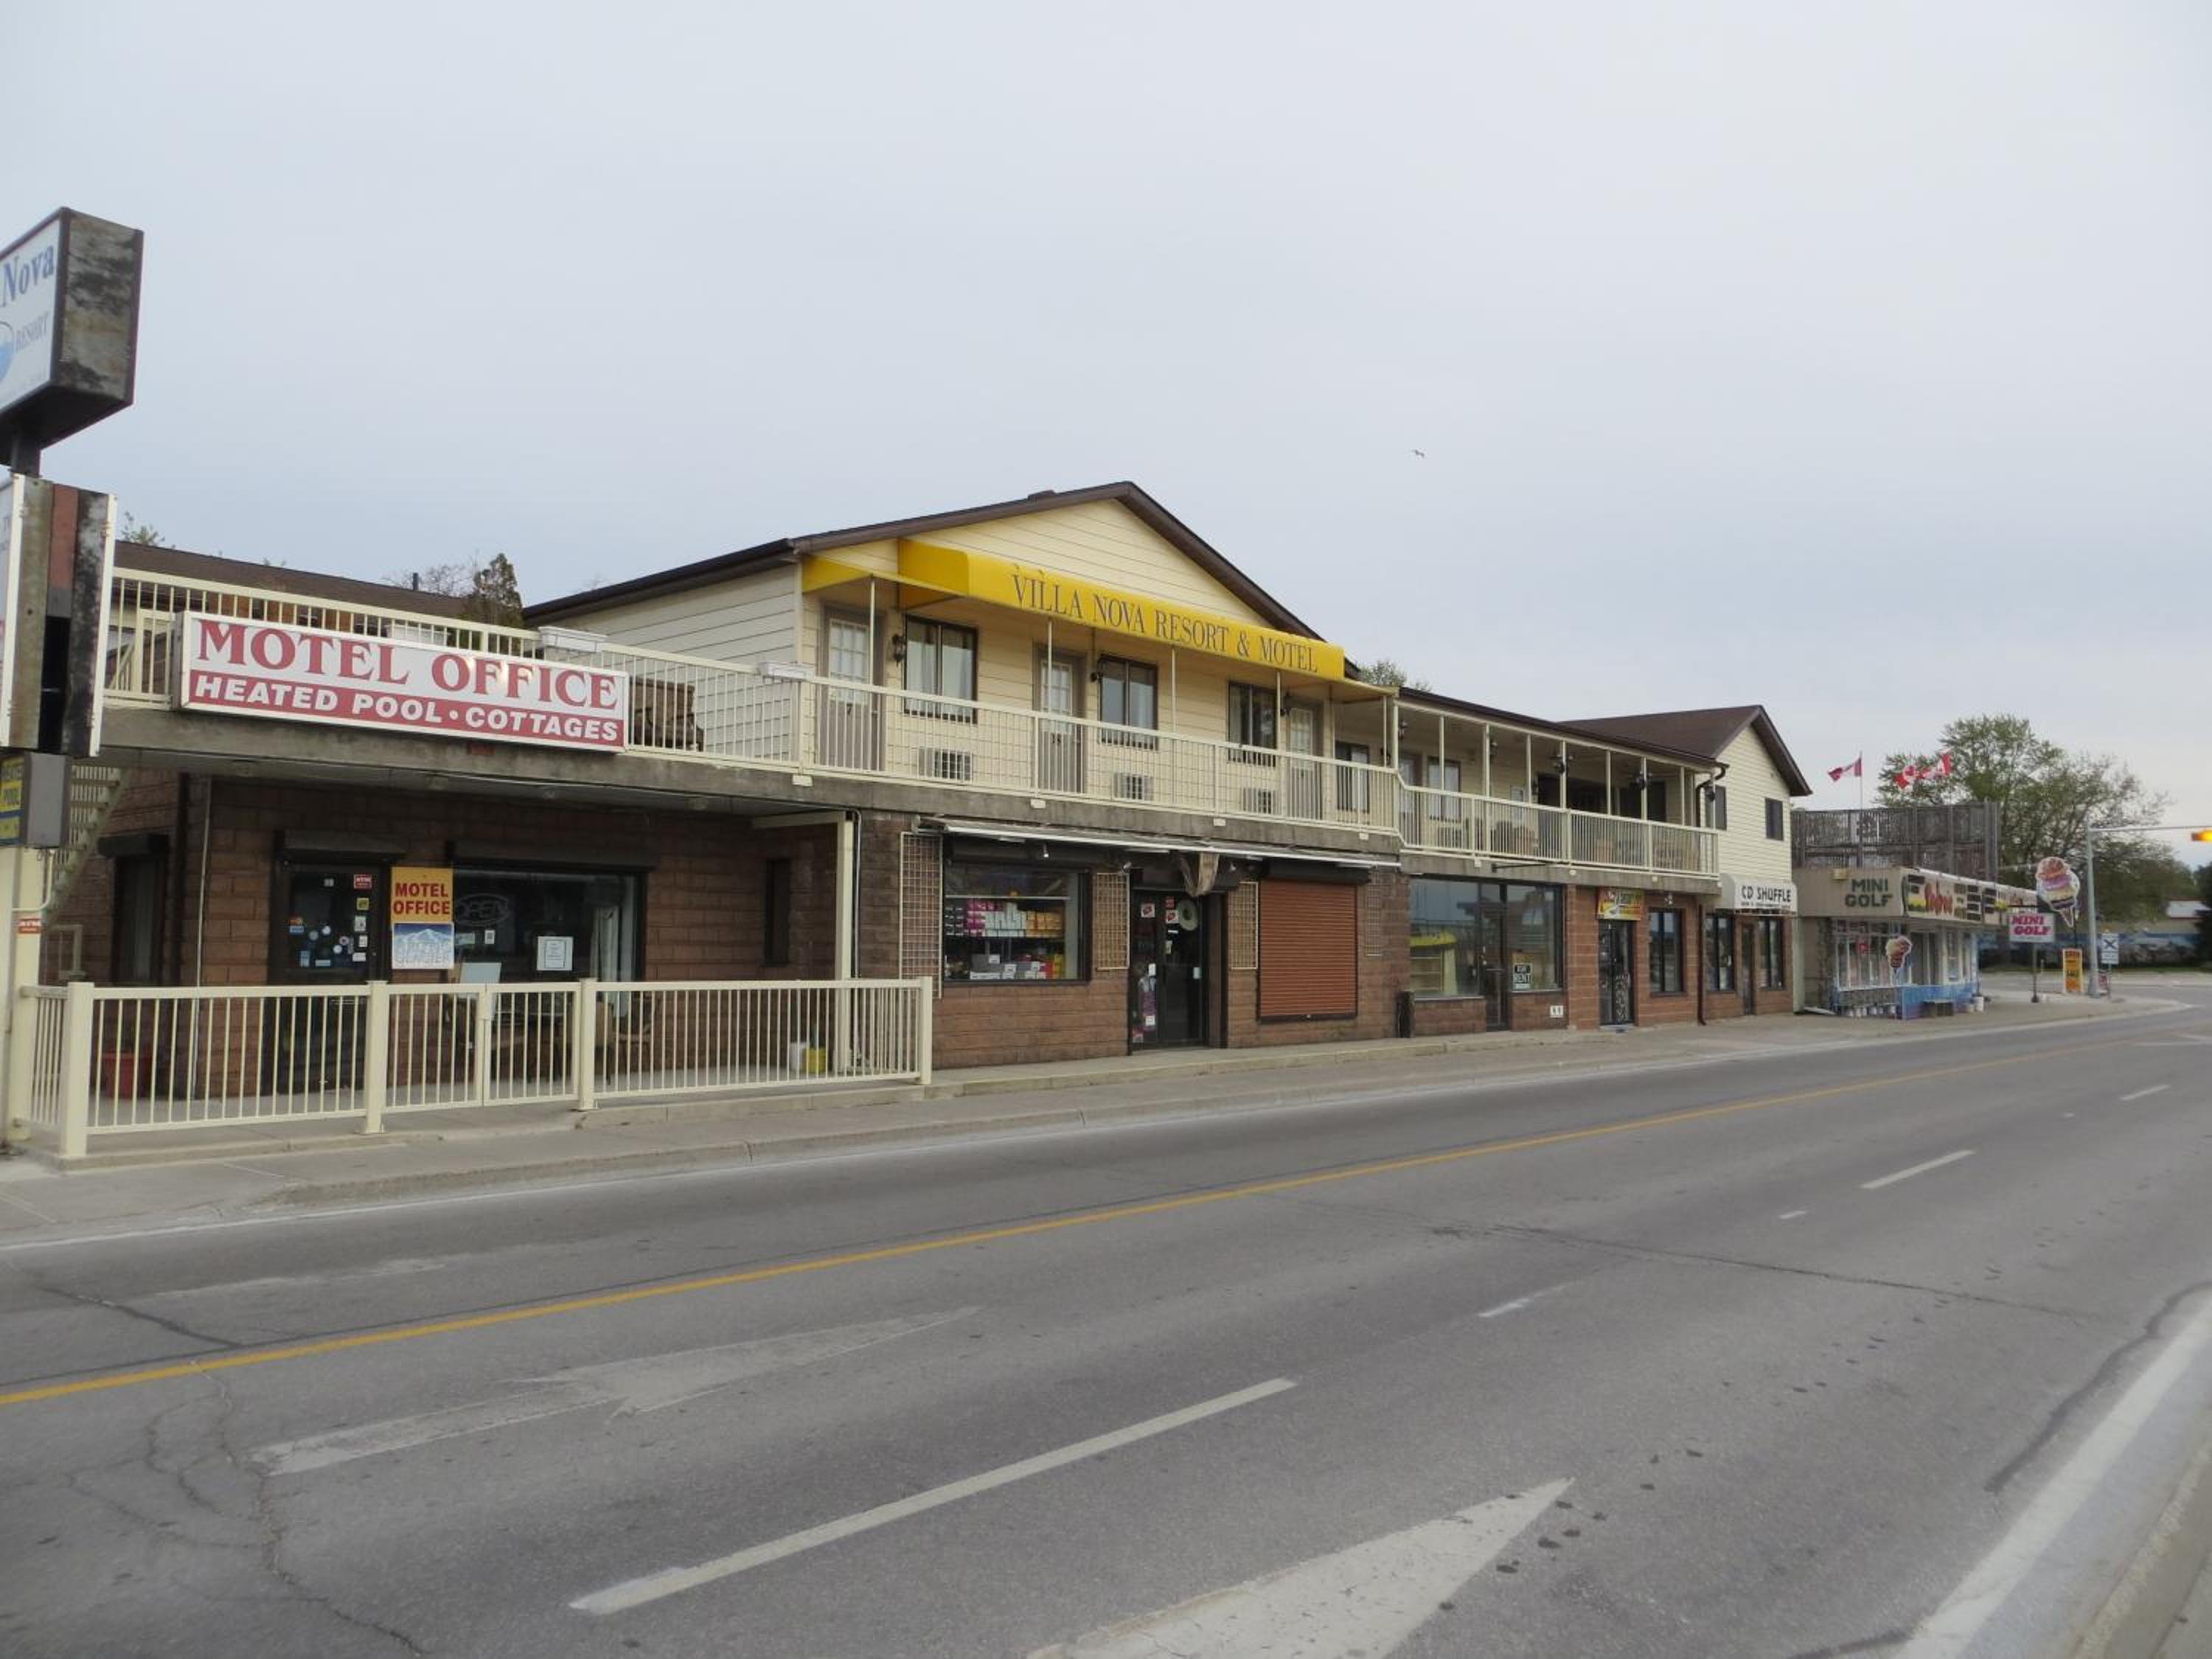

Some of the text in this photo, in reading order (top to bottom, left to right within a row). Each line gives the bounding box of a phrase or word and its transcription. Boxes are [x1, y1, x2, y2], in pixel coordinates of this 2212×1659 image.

[1, 245, 55, 307] Nova
[1011, 574, 1318, 672] VILLA NOVA RESORT & MOTEL
[198, 619, 619, 710] MOTEL OFFICE
[195, 673, 619, 741] HEATED POOL COTTAGES
[395, 883, 449, 897] MOTEL
[1851, 877, 1888, 893] MINI
[1741, 885, 1792, 903] CD SHUFFLE
[1845, 894, 1893, 908] GOLF
[393, 900, 451, 915] OFFICE
[2012, 915, 2045, 925] MINI
[2014, 925, 2051, 936] GOLF
